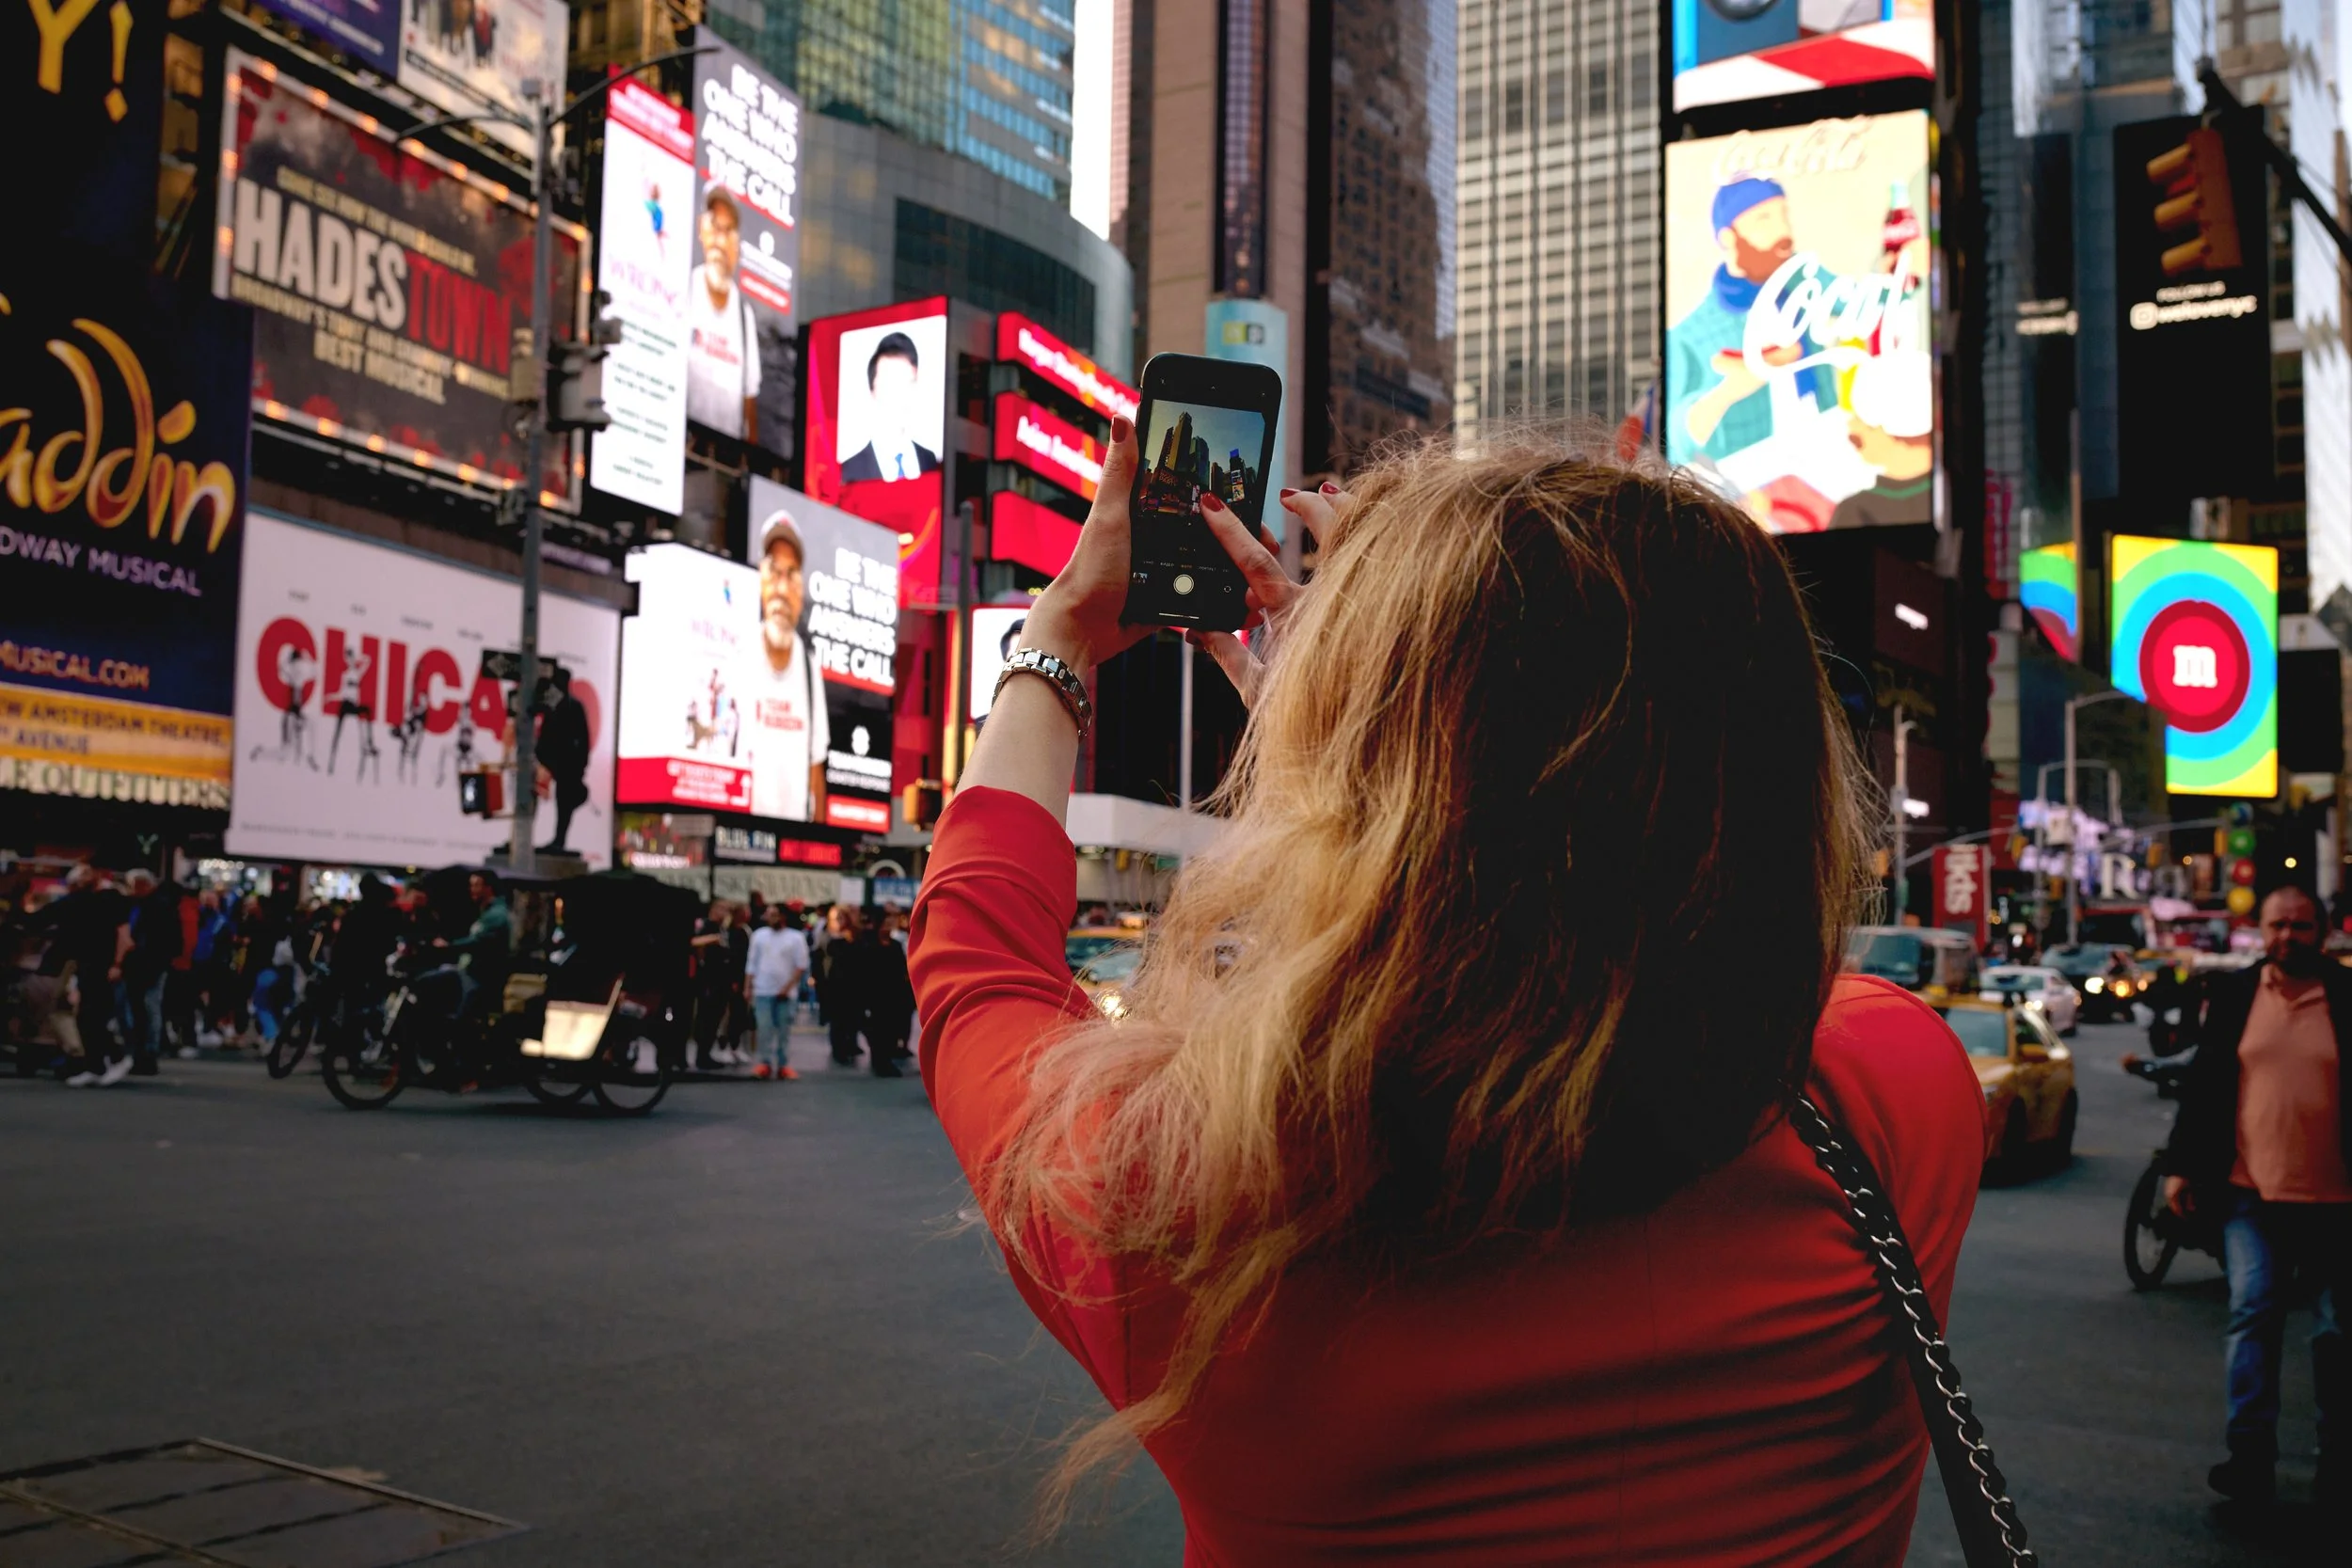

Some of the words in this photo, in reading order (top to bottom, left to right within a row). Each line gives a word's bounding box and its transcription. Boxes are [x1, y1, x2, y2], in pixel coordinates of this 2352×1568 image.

[88, 547, 201, 596] MUSICAL
[256, 616, 601, 758] CHICA
[850, 647, 895, 687] CALL
